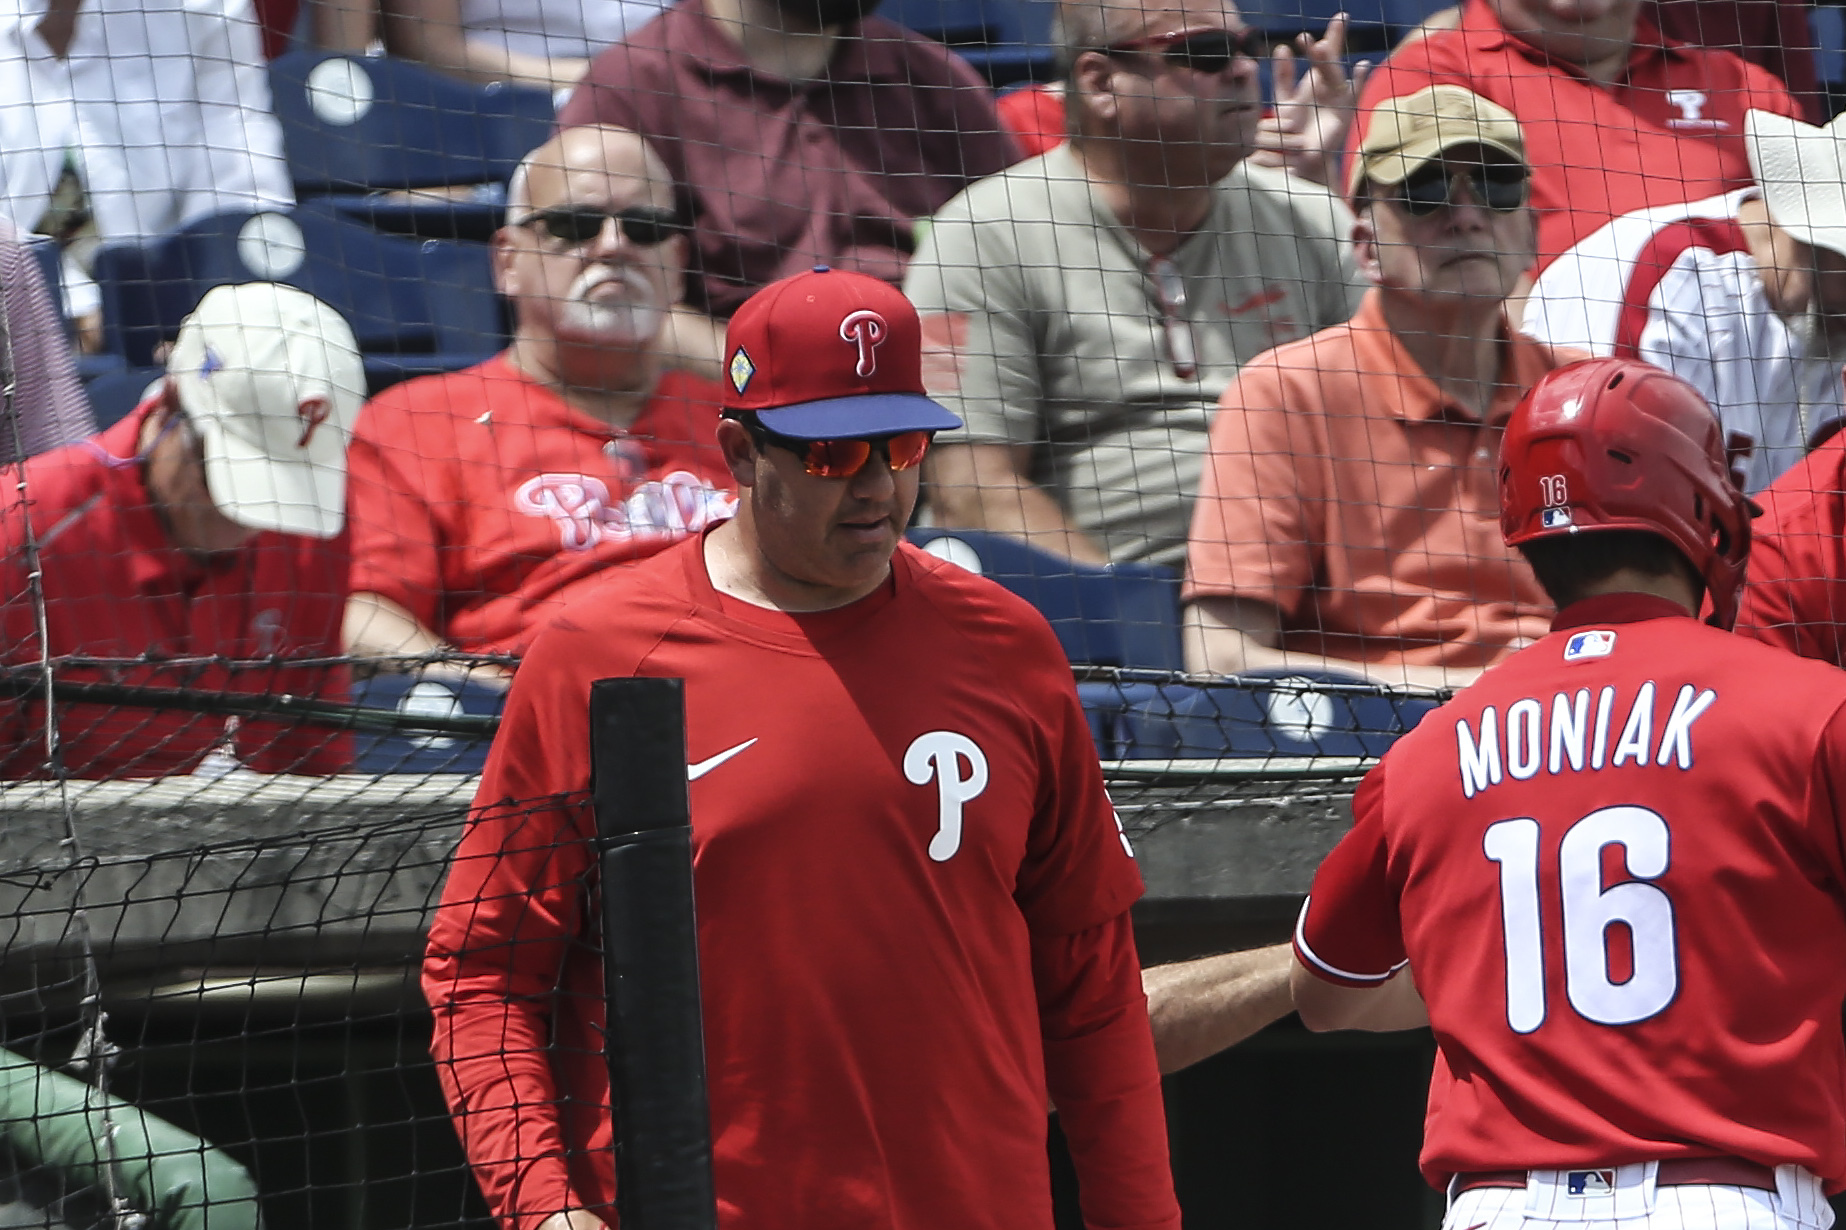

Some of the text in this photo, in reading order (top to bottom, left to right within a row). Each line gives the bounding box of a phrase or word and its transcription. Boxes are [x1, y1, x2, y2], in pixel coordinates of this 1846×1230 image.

[839, 309, 888, 378] P
[1539, 474, 1568, 507] 16
[902, 730, 989, 862] P
[1455, 679, 1718, 799] MONIAK
[1483, 803, 1681, 1035] 16
